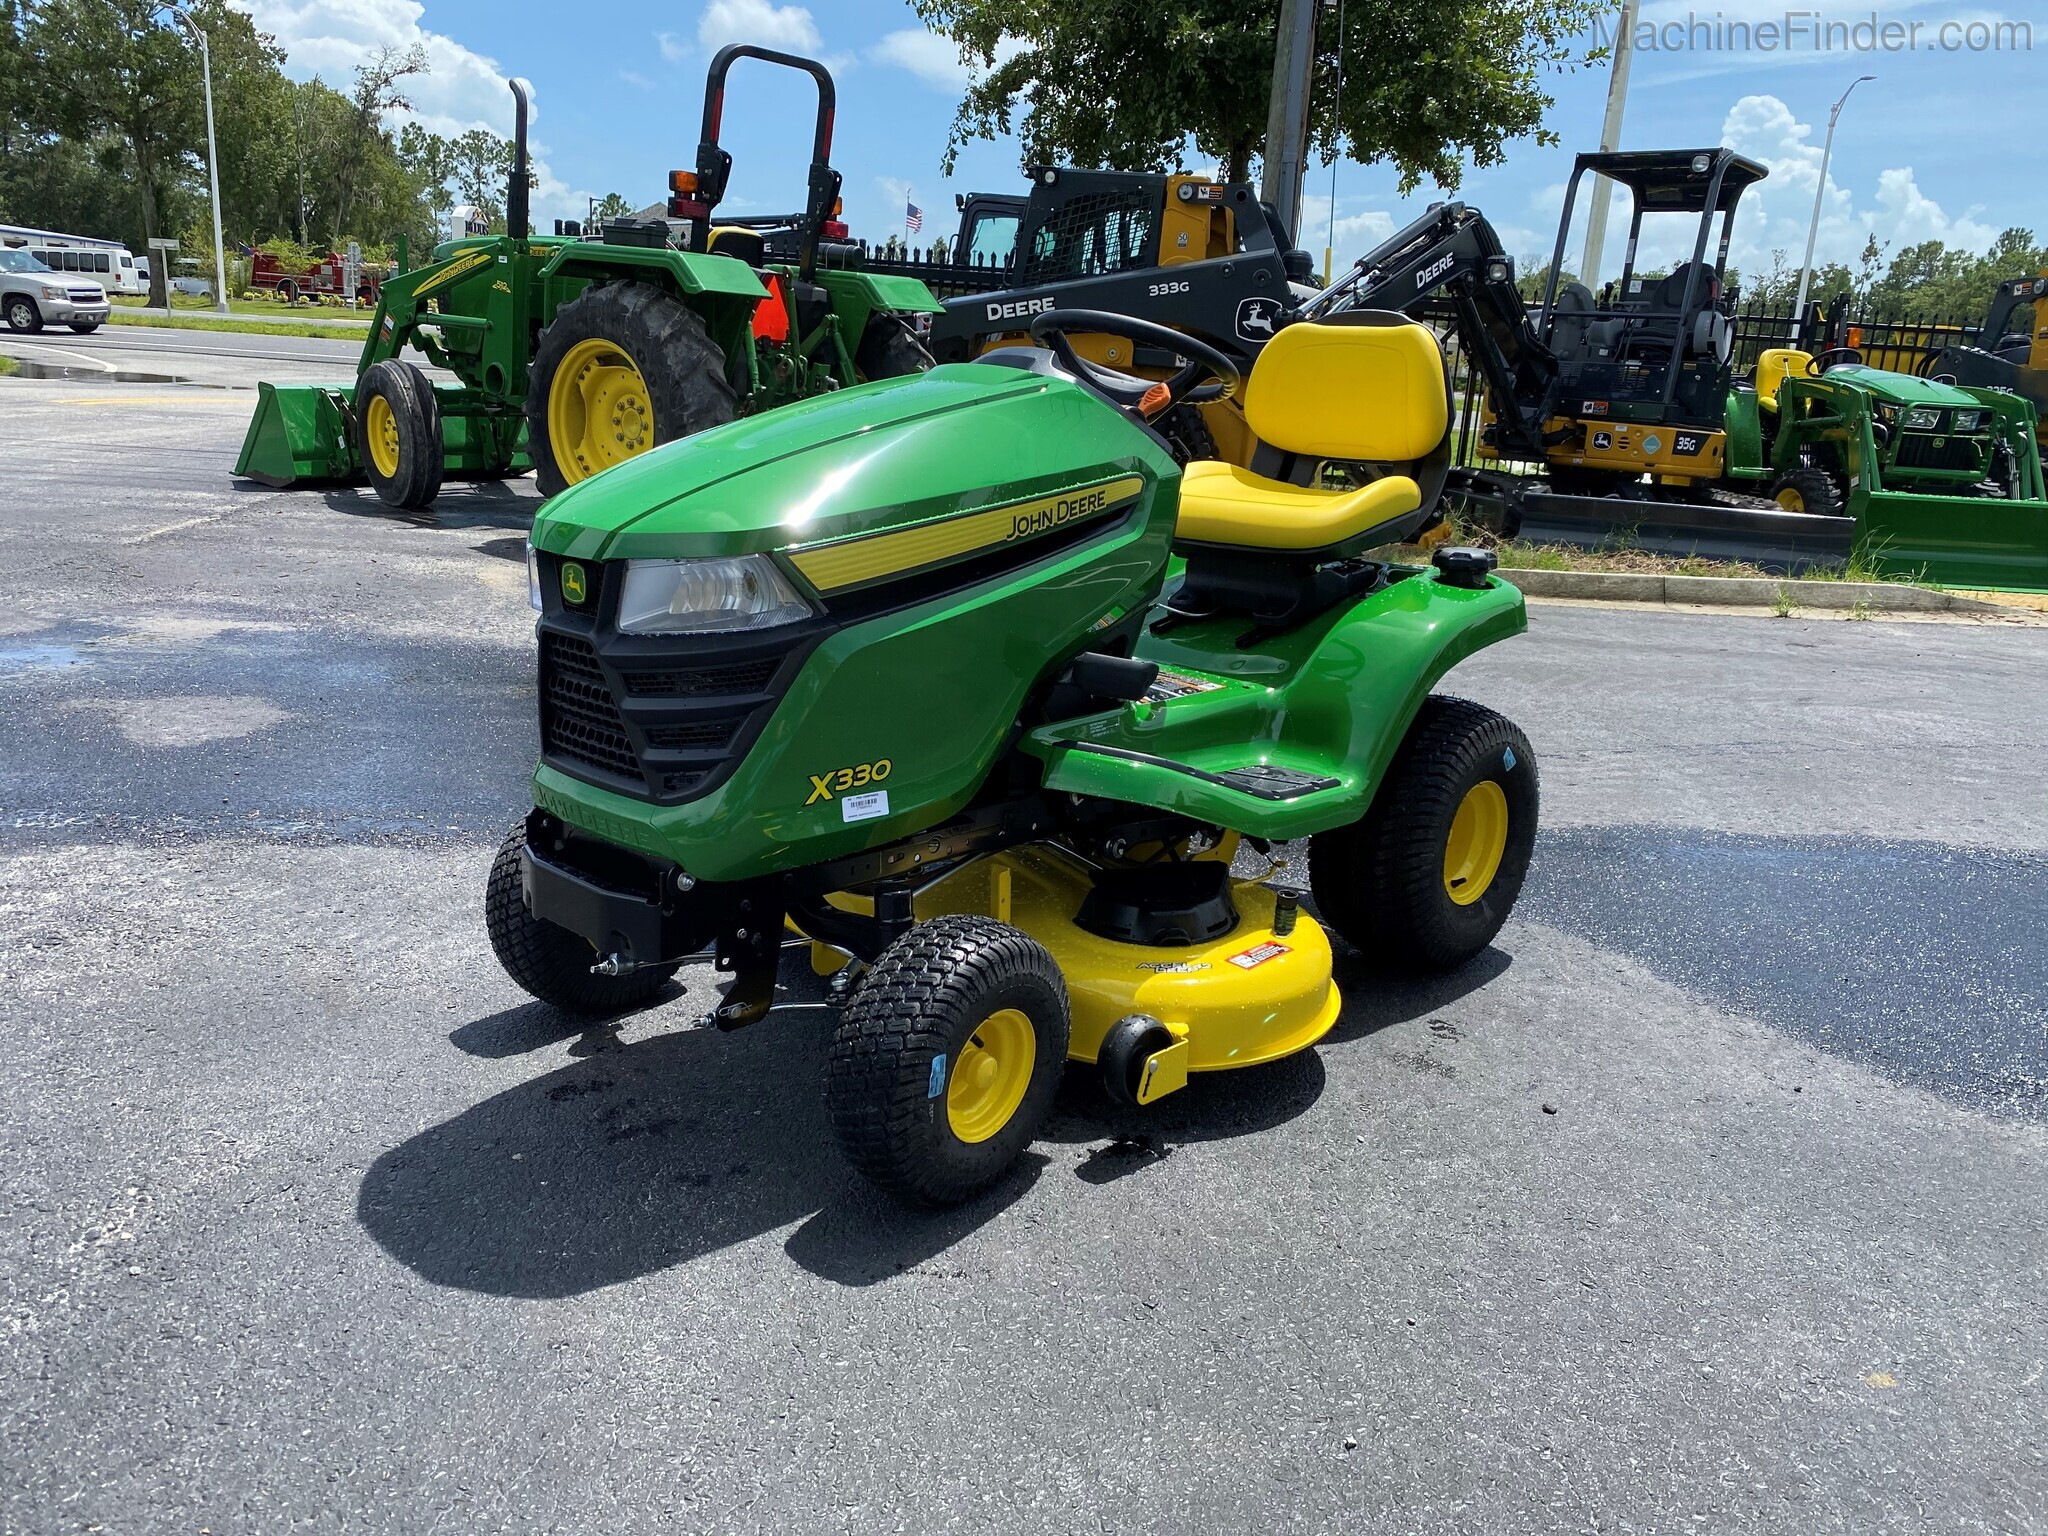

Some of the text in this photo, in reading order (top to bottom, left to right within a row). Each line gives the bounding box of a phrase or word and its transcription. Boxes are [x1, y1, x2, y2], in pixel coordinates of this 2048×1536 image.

[453, 257, 475, 274] DEERE
[1416, 251, 1454, 289] DEERE
[1148, 281, 1190, 297] 333G
[986, 296, 1056, 321] DEERE
[1676, 436, 1696, 451] 35G
[1006, 490, 1106, 540] JOHN DEERE
[803, 758, 892, 807] X330
